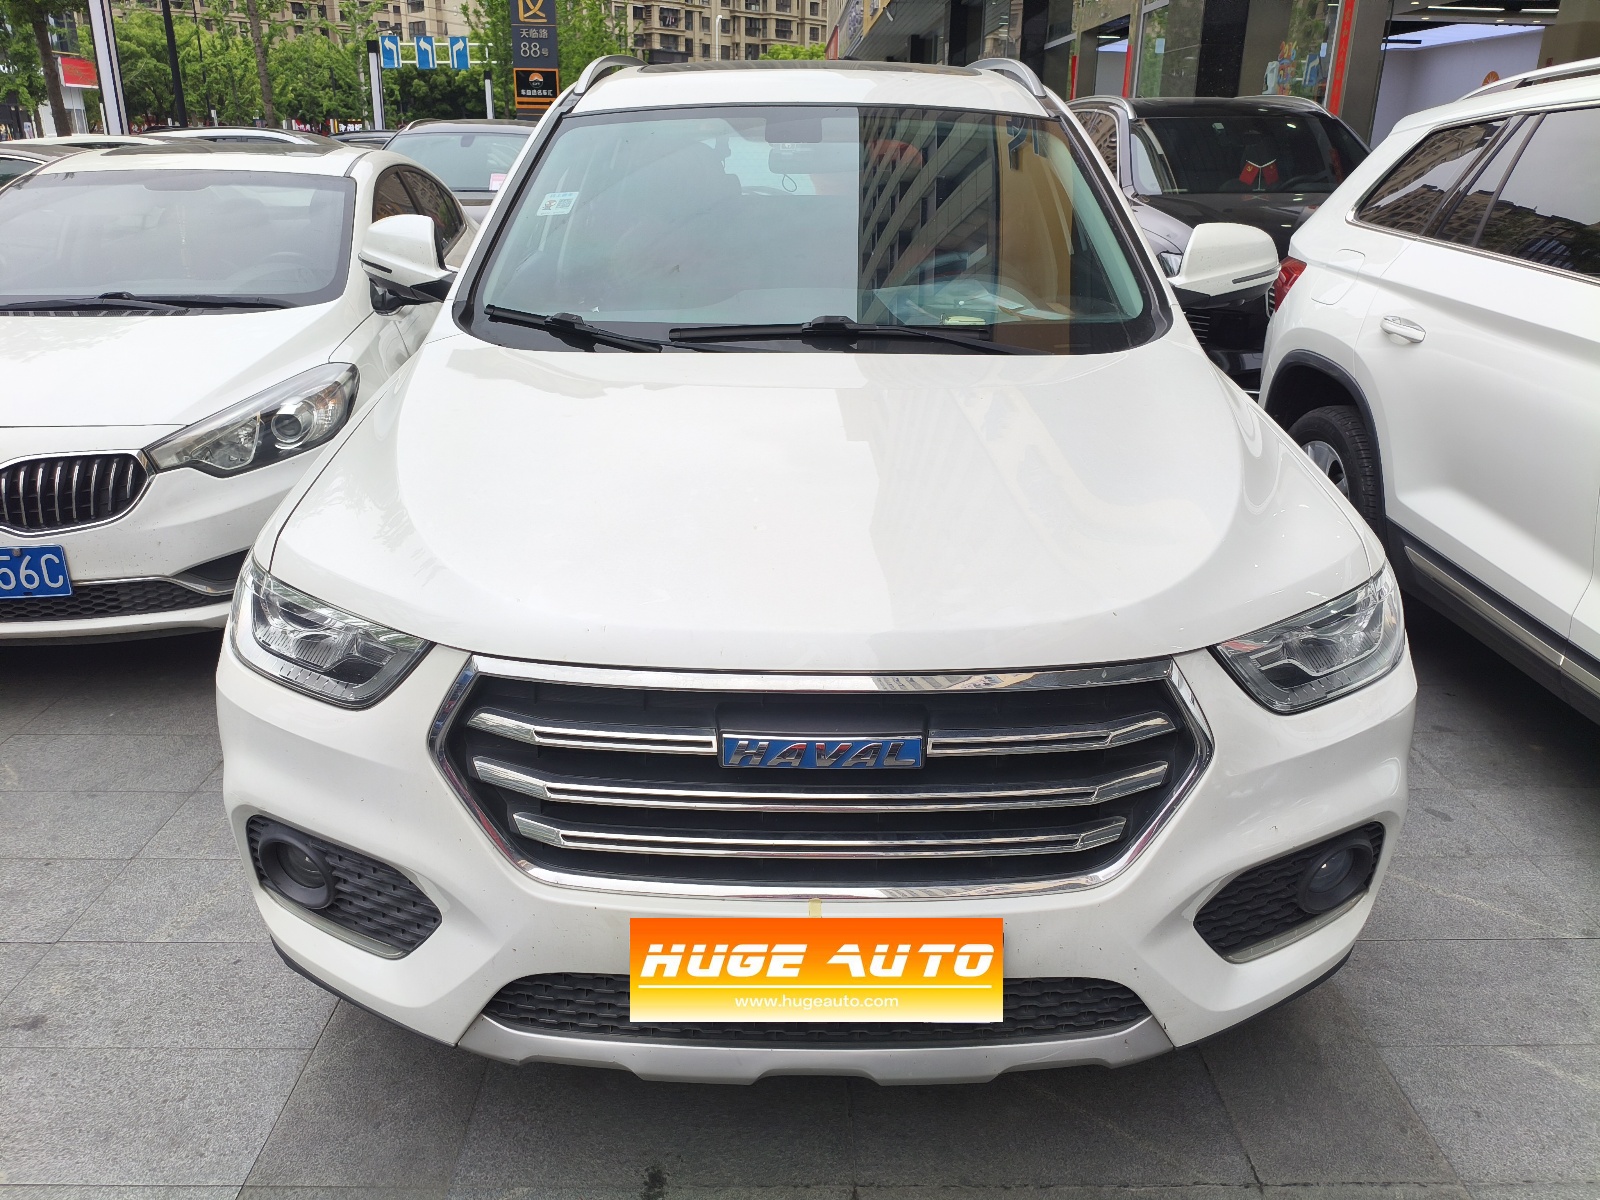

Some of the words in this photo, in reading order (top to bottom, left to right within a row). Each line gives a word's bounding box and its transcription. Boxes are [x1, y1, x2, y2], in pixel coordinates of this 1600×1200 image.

[520, 28, 548, 38] 天临路
[0, 553, 64, 590] 56C
[728, 740, 916, 767] HAVAL
